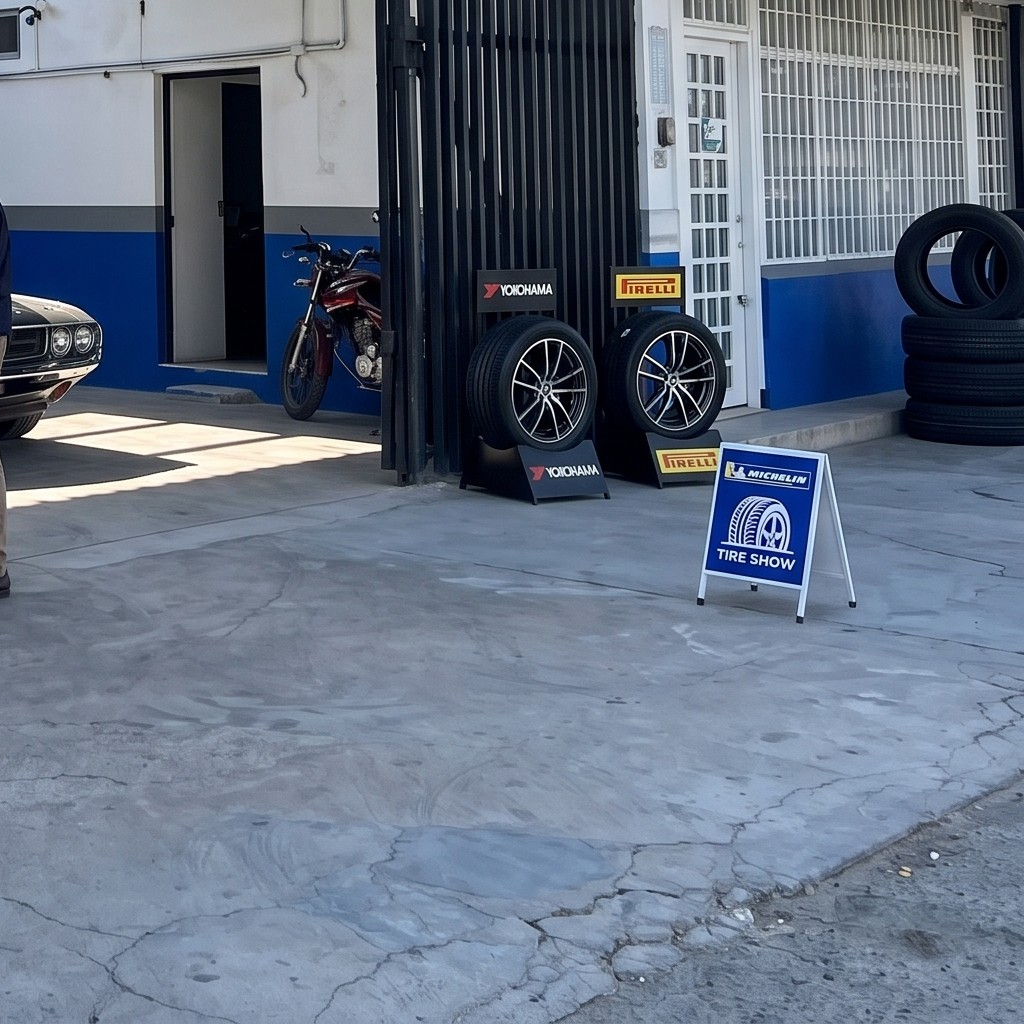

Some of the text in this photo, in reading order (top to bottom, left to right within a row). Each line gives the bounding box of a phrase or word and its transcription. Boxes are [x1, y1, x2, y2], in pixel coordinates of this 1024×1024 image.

[621, 278, 676, 295] PIRELLI
[662, 452, 717, 468] PIRELLI
[747, 469, 807, 485] MICHELIN
[716, 548, 796, 571] TIRE SHOW
